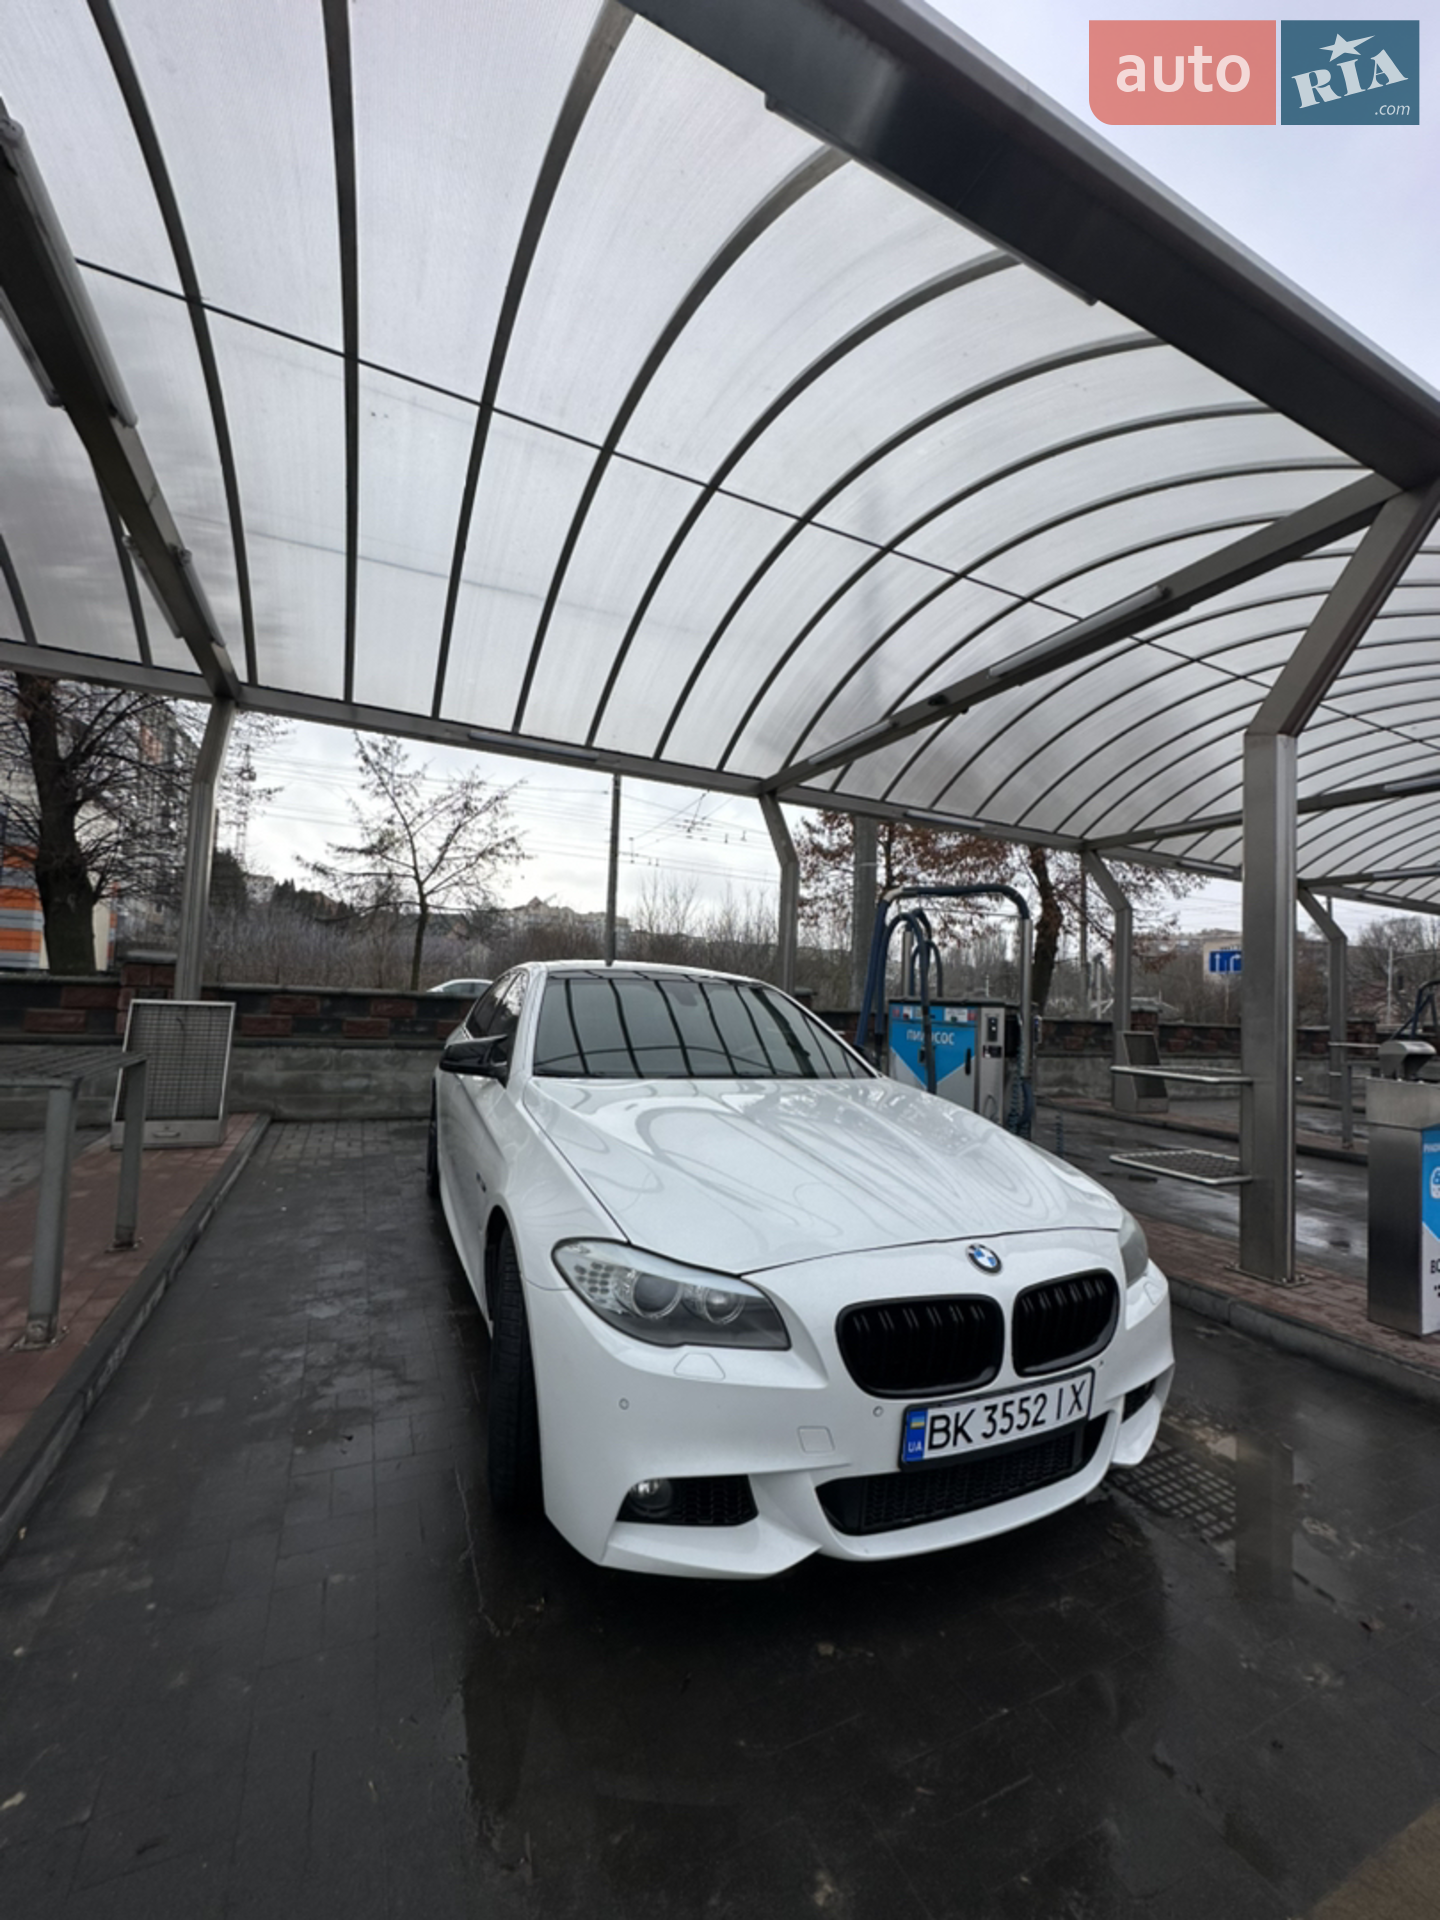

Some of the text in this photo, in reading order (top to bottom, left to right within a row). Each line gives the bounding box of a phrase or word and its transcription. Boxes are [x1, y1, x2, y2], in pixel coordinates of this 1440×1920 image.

[927, 1408, 976, 1451] BK
[981, 1392, 1048, 1439] 3552
[908, 1440, 923, 1453] UA
